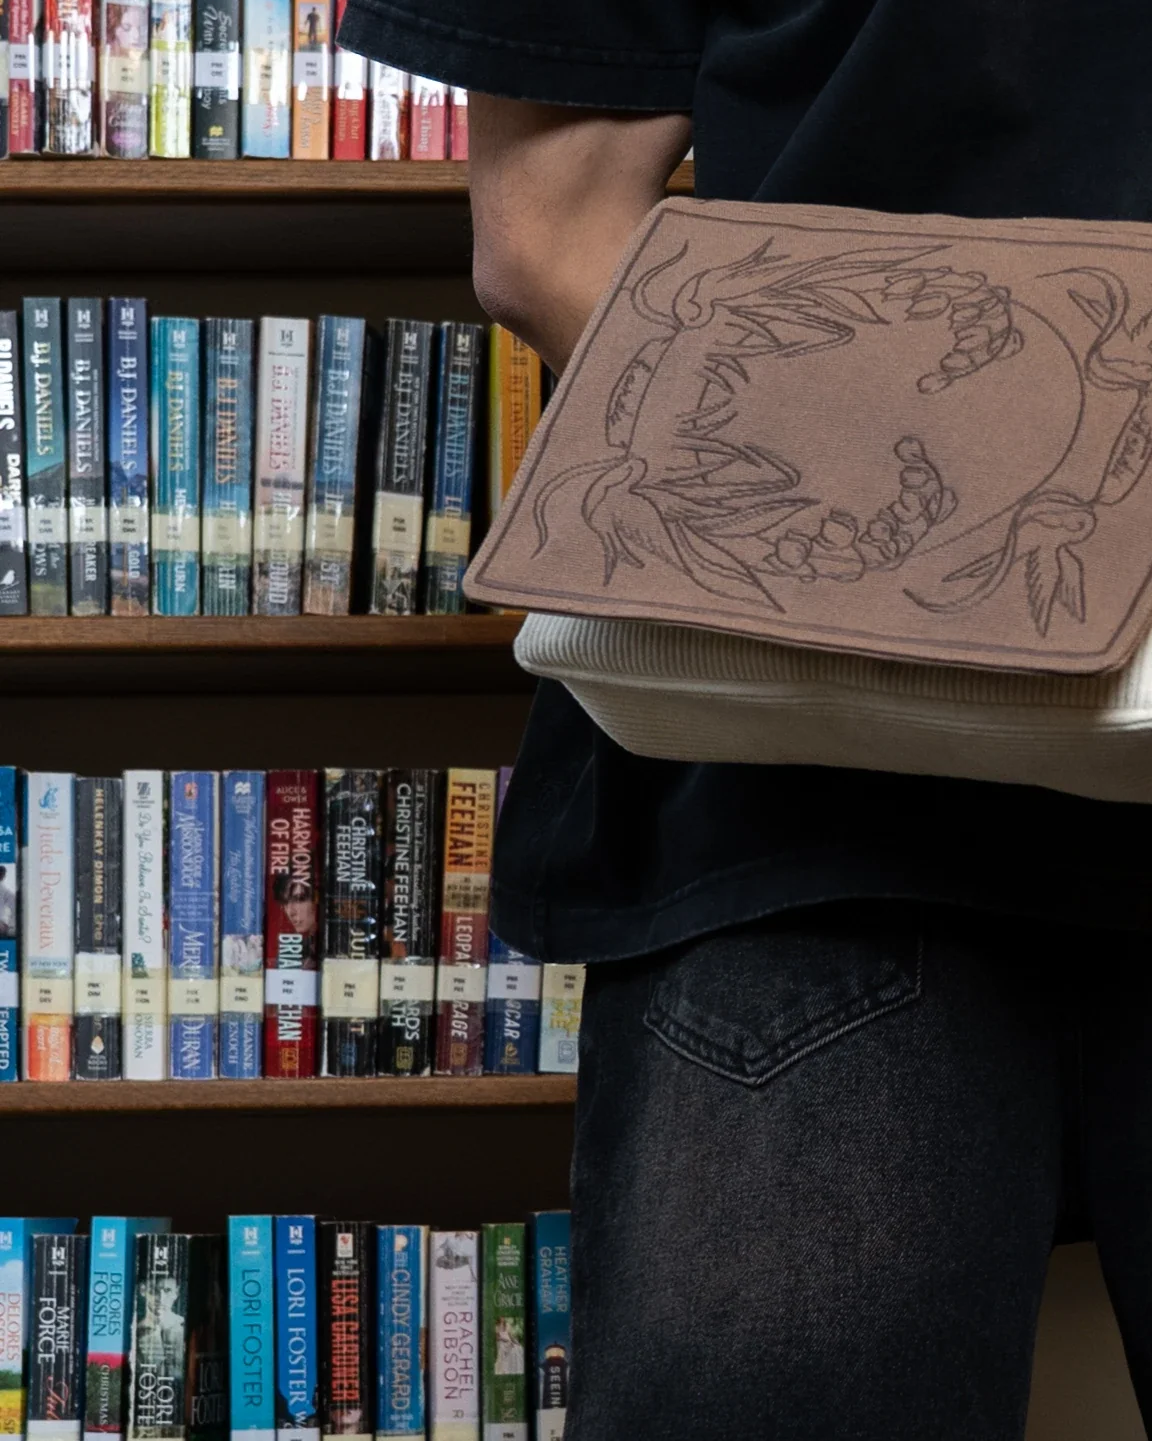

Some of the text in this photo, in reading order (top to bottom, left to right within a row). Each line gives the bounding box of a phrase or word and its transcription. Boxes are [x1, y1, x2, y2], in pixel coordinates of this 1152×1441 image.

[75, 391, 91, 473] DANIELS
[120, 388, 136, 470] DANIELS
[137, 832, 152, 849] You
[138, 812, 152, 830] Do
[270, 819, 287, 875] OF FIRE
[292, 808, 310, 887] HARMONY
[394, 783, 409, 941] CHRISTINE FEEHAN
[448, 782, 476, 867] FEEHAN
[475, 782, 491, 868] CHRISTINE
[94, 788, 104, 941] HELENKAY DIMON the
[138, 852, 152, 888] Believe
[39, 1297, 56, 1364] FORCE
[57, 1307, 69, 1353] MARIE
[93, 1271, 107, 1336] FOSSEN
[109, 1272, 121, 1335] DELORES
[242, 1269, 261, 1406] LORI FOSTER
[288, 1269, 306, 1405] LORI FOSTER
[332, 1280, 359, 1401] LISA GARDNER
[391, 1269, 410, 1409] CINDY GERARD
[444, 1311, 458, 1400] GIBSON
[459, 1312, 473, 1399] RACHEL
[157, 1377, 174, 1425] LORI
